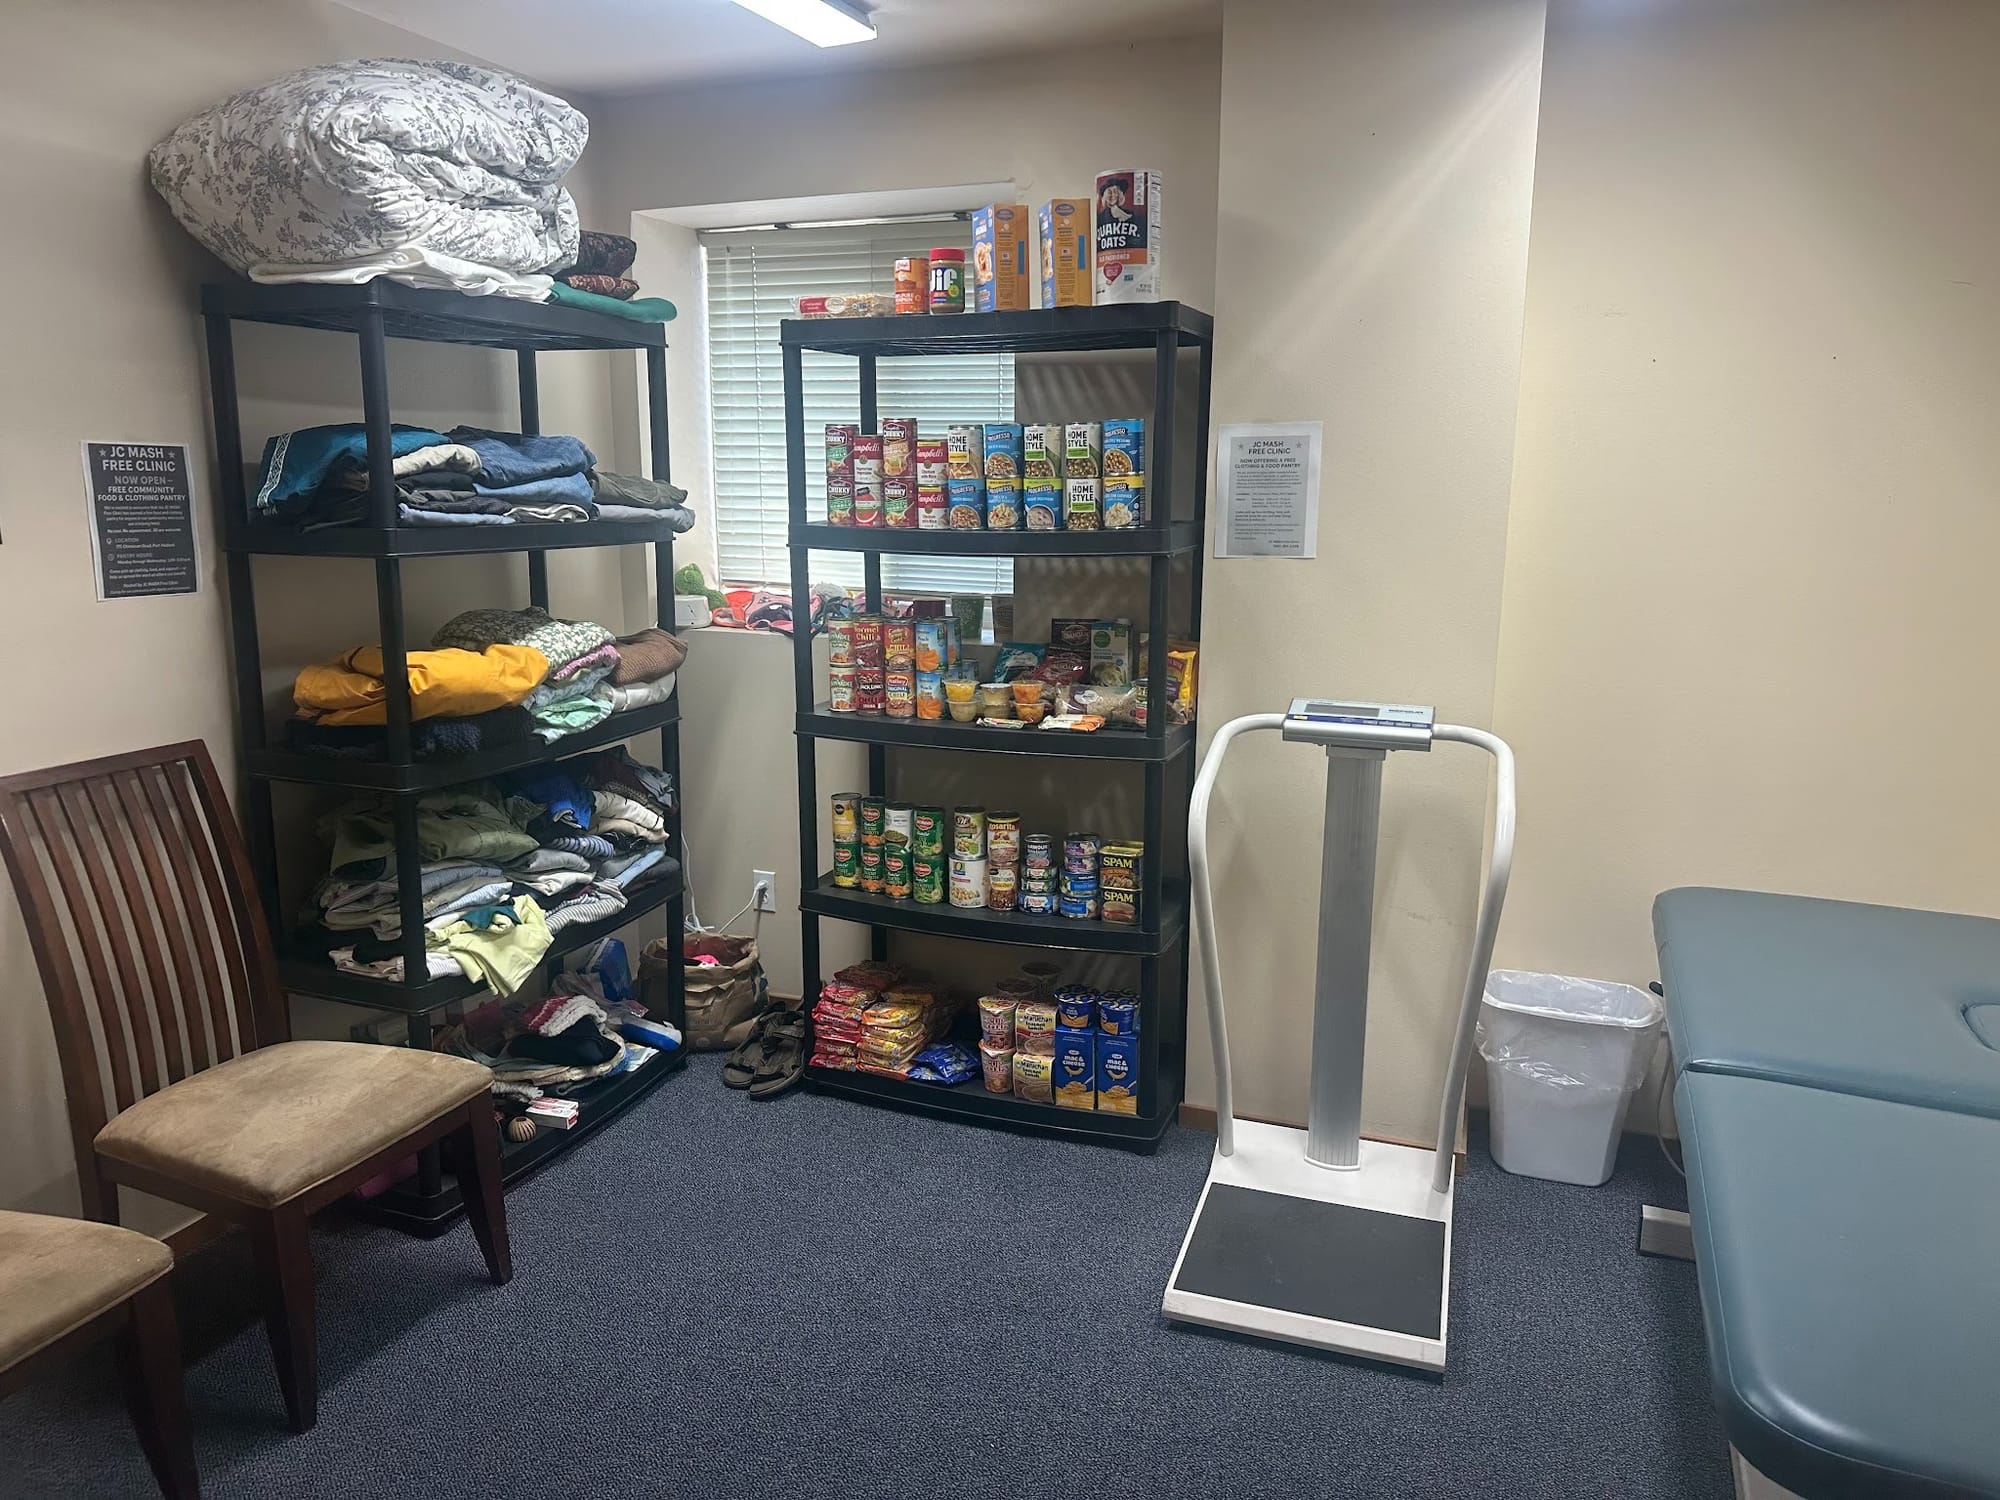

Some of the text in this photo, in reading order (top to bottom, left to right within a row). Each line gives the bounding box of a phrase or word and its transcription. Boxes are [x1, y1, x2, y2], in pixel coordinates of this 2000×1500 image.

[1101, 236, 1126, 249] OATS
[930, 268, 957, 291] Jif
[1025, 433, 1044, 441] HOME
[1067, 430, 1088, 439] HOME
[853, 442, 880, 453] ampbell's
[1025, 442, 1044, 450] STYLE
[1067, 439, 1088, 447] STYLE
[1262, 440, 1284, 448] MASH
[110, 446, 164, 459] JC MASH
[1267, 447, 1291, 455] CLINIC
[102, 459, 176, 472] FREE CLINIC
[114, 475, 138, 484] NOW
[140, 475, 166, 485] OPEN
[128, 486, 175, 494] COMMUNITY
[1072, 485, 1094, 493] HOME
[1072, 493, 1094, 502] STYLE
[1103, 856, 1133, 868] SPAM
[1104, 891, 1134, 903] SPAM
[1023, 1015, 1053, 1023] Maruchan
[1020, 1060, 1049, 1071] Maruchan
